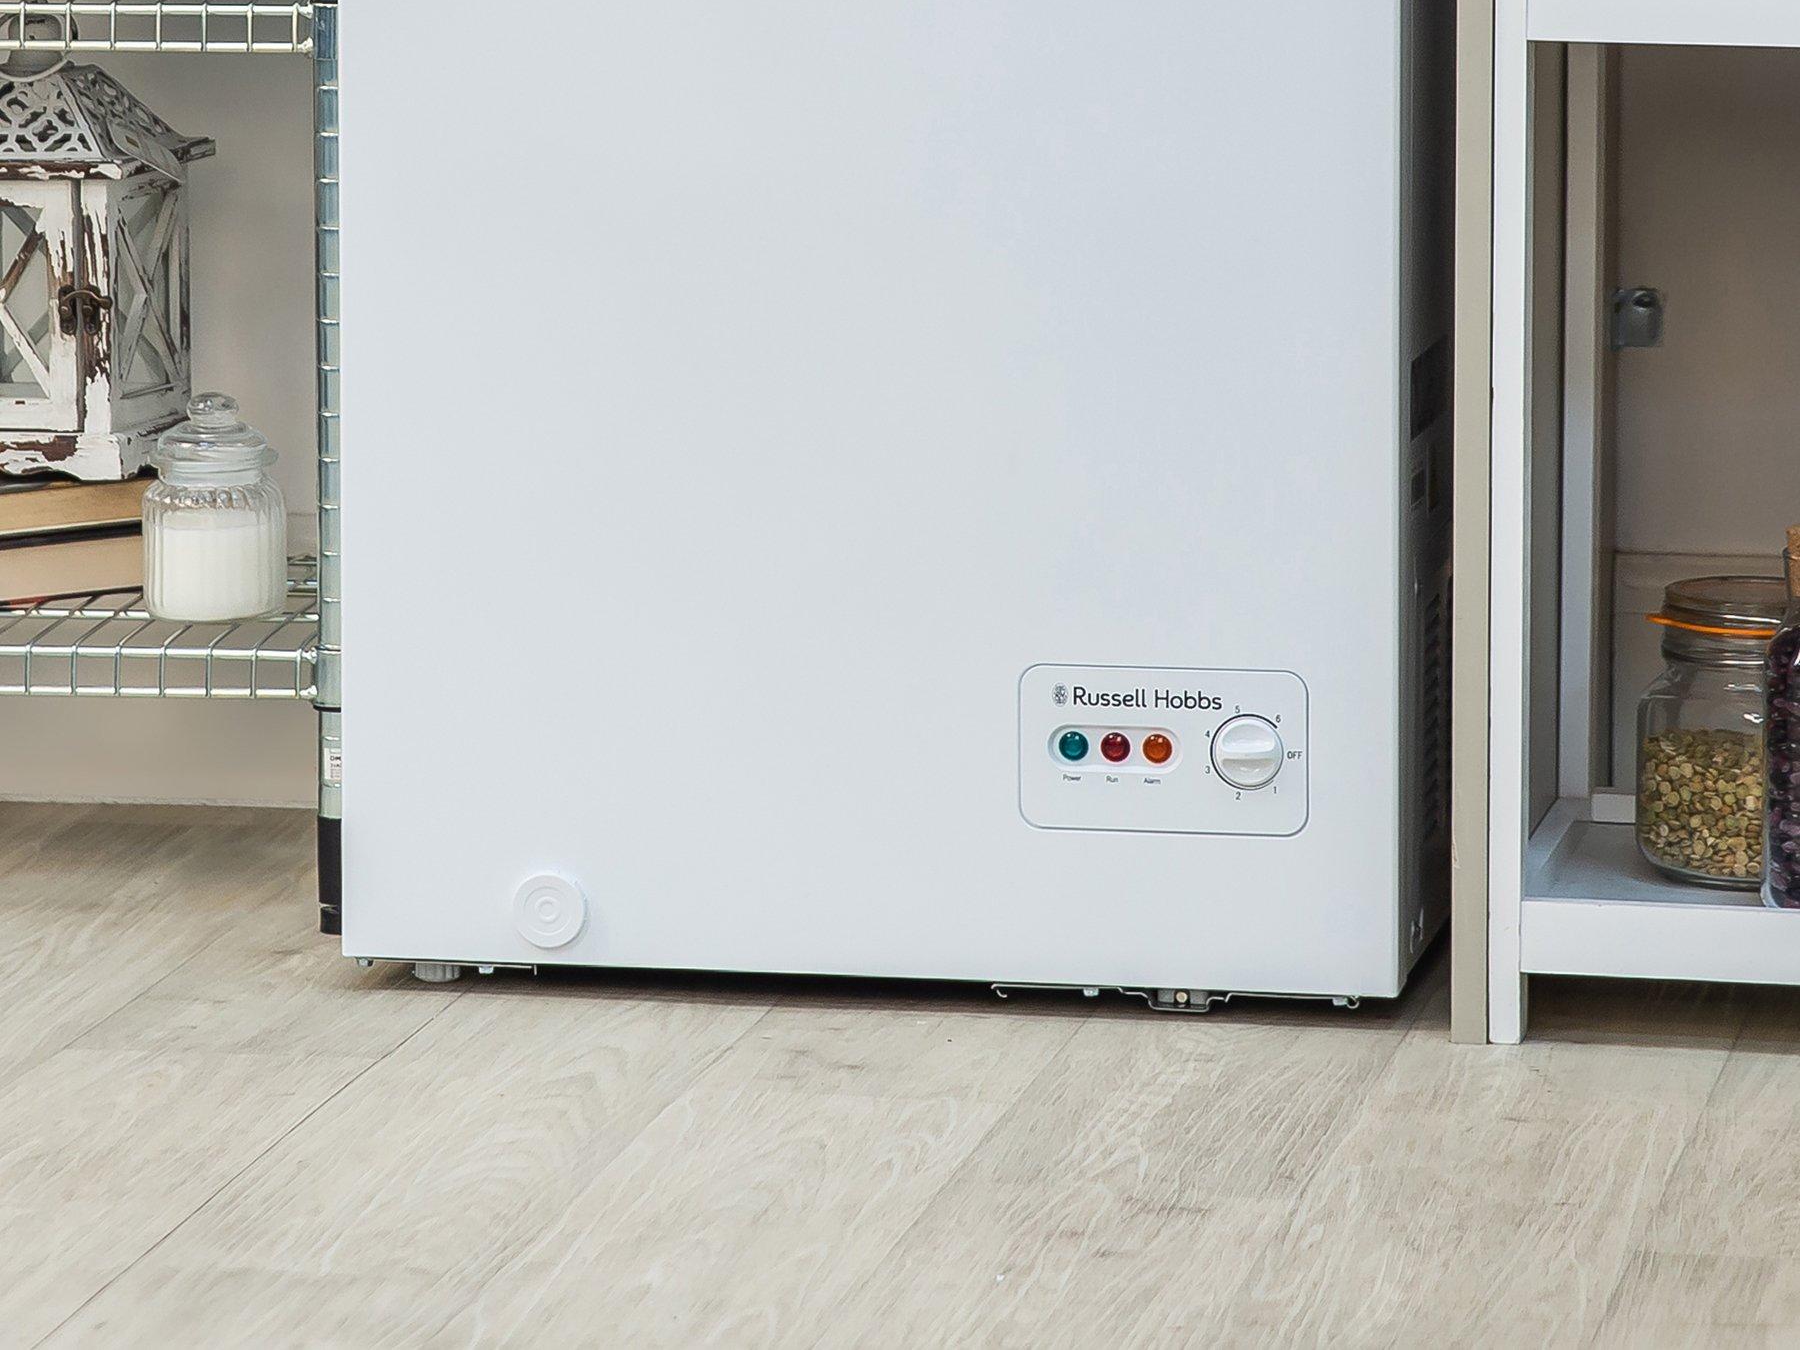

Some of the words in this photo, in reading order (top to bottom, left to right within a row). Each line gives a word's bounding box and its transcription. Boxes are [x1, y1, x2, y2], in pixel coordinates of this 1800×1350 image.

[1073, 686, 1147, 708] Russell
[1154, 689, 1223, 710] Hobbs
[1235, 705, 1241, 714] 5
[1275, 714, 1281, 723] 6
[1205, 730, 1210, 738] 4
[1286, 751, 1303, 759] OFF
[1204, 765, 1211, 774] 3
[1106, 775, 1119, 783] Run
[1143, 777, 1161, 785] Alarm
[1235, 791, 1241, 800] 2
